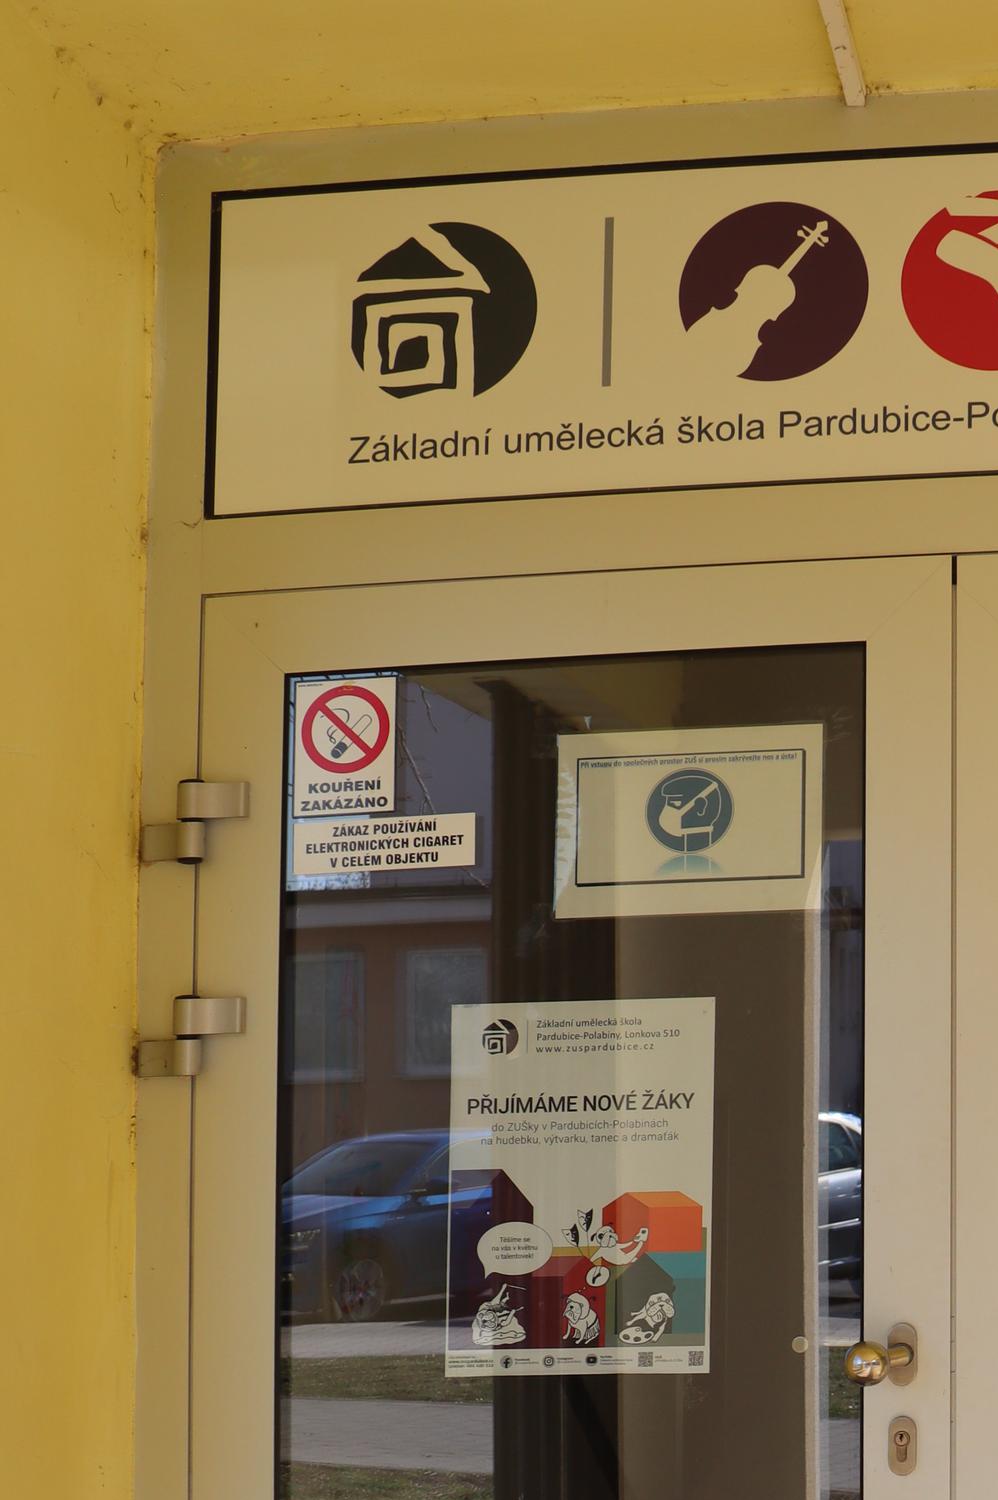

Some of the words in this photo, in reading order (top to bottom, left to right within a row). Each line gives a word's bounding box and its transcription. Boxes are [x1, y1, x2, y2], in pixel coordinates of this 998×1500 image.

[348, 427, 493, 464] Základní
[503, 417, 666, 456] umělecká
[677, 412, 766, 446] škola
[308, 777, 381, 794] KOUŘENÍ
[300, 795, 388, 812] ZAKÁZÁNO
[332, 823, 369, 837] ZÁKAZ
[373, 818, 437, 835] POUŽÍVÁNÍ
[305, 835, 410, 854] ELEKTRONICKÝCH
[413, 834, 464, 848] CIGARET
[329, 857, 338, 868] V
[341, 854, 382, 867] CELÉM
[385, 851, 439, 865] OBJEKTU
[536, 1018, 574, 1029] Základní
[575, 1017, 618, 1028] umělecká
[619, 1016, 642, 1026] škola
[536, 1029, 622, 1042] Pardubice-Polabiny,
[624, 1029, 662, 1040] Lonkova
[662, 1028, 681, 1038] 510
[535, 1041, 655, 1054] www.zuspardubice.cz
[466, 1092, 578, 1115] PŘIJÍMÁME
[583, 1090, 638, 1112] NOVÉ
[641, 1089, 696, 1111] ŽÁKY
[491, 1121, 505, 1132] do
[507, 1120, 540, 1134] ZUŠky
[480, 1136, 494, 1146] na
[495, 1134, 542, 1147] hudebku,
[543, 1132, 589, 1147] výtvarku,
[590, 1133, 620, 1144] tanec
